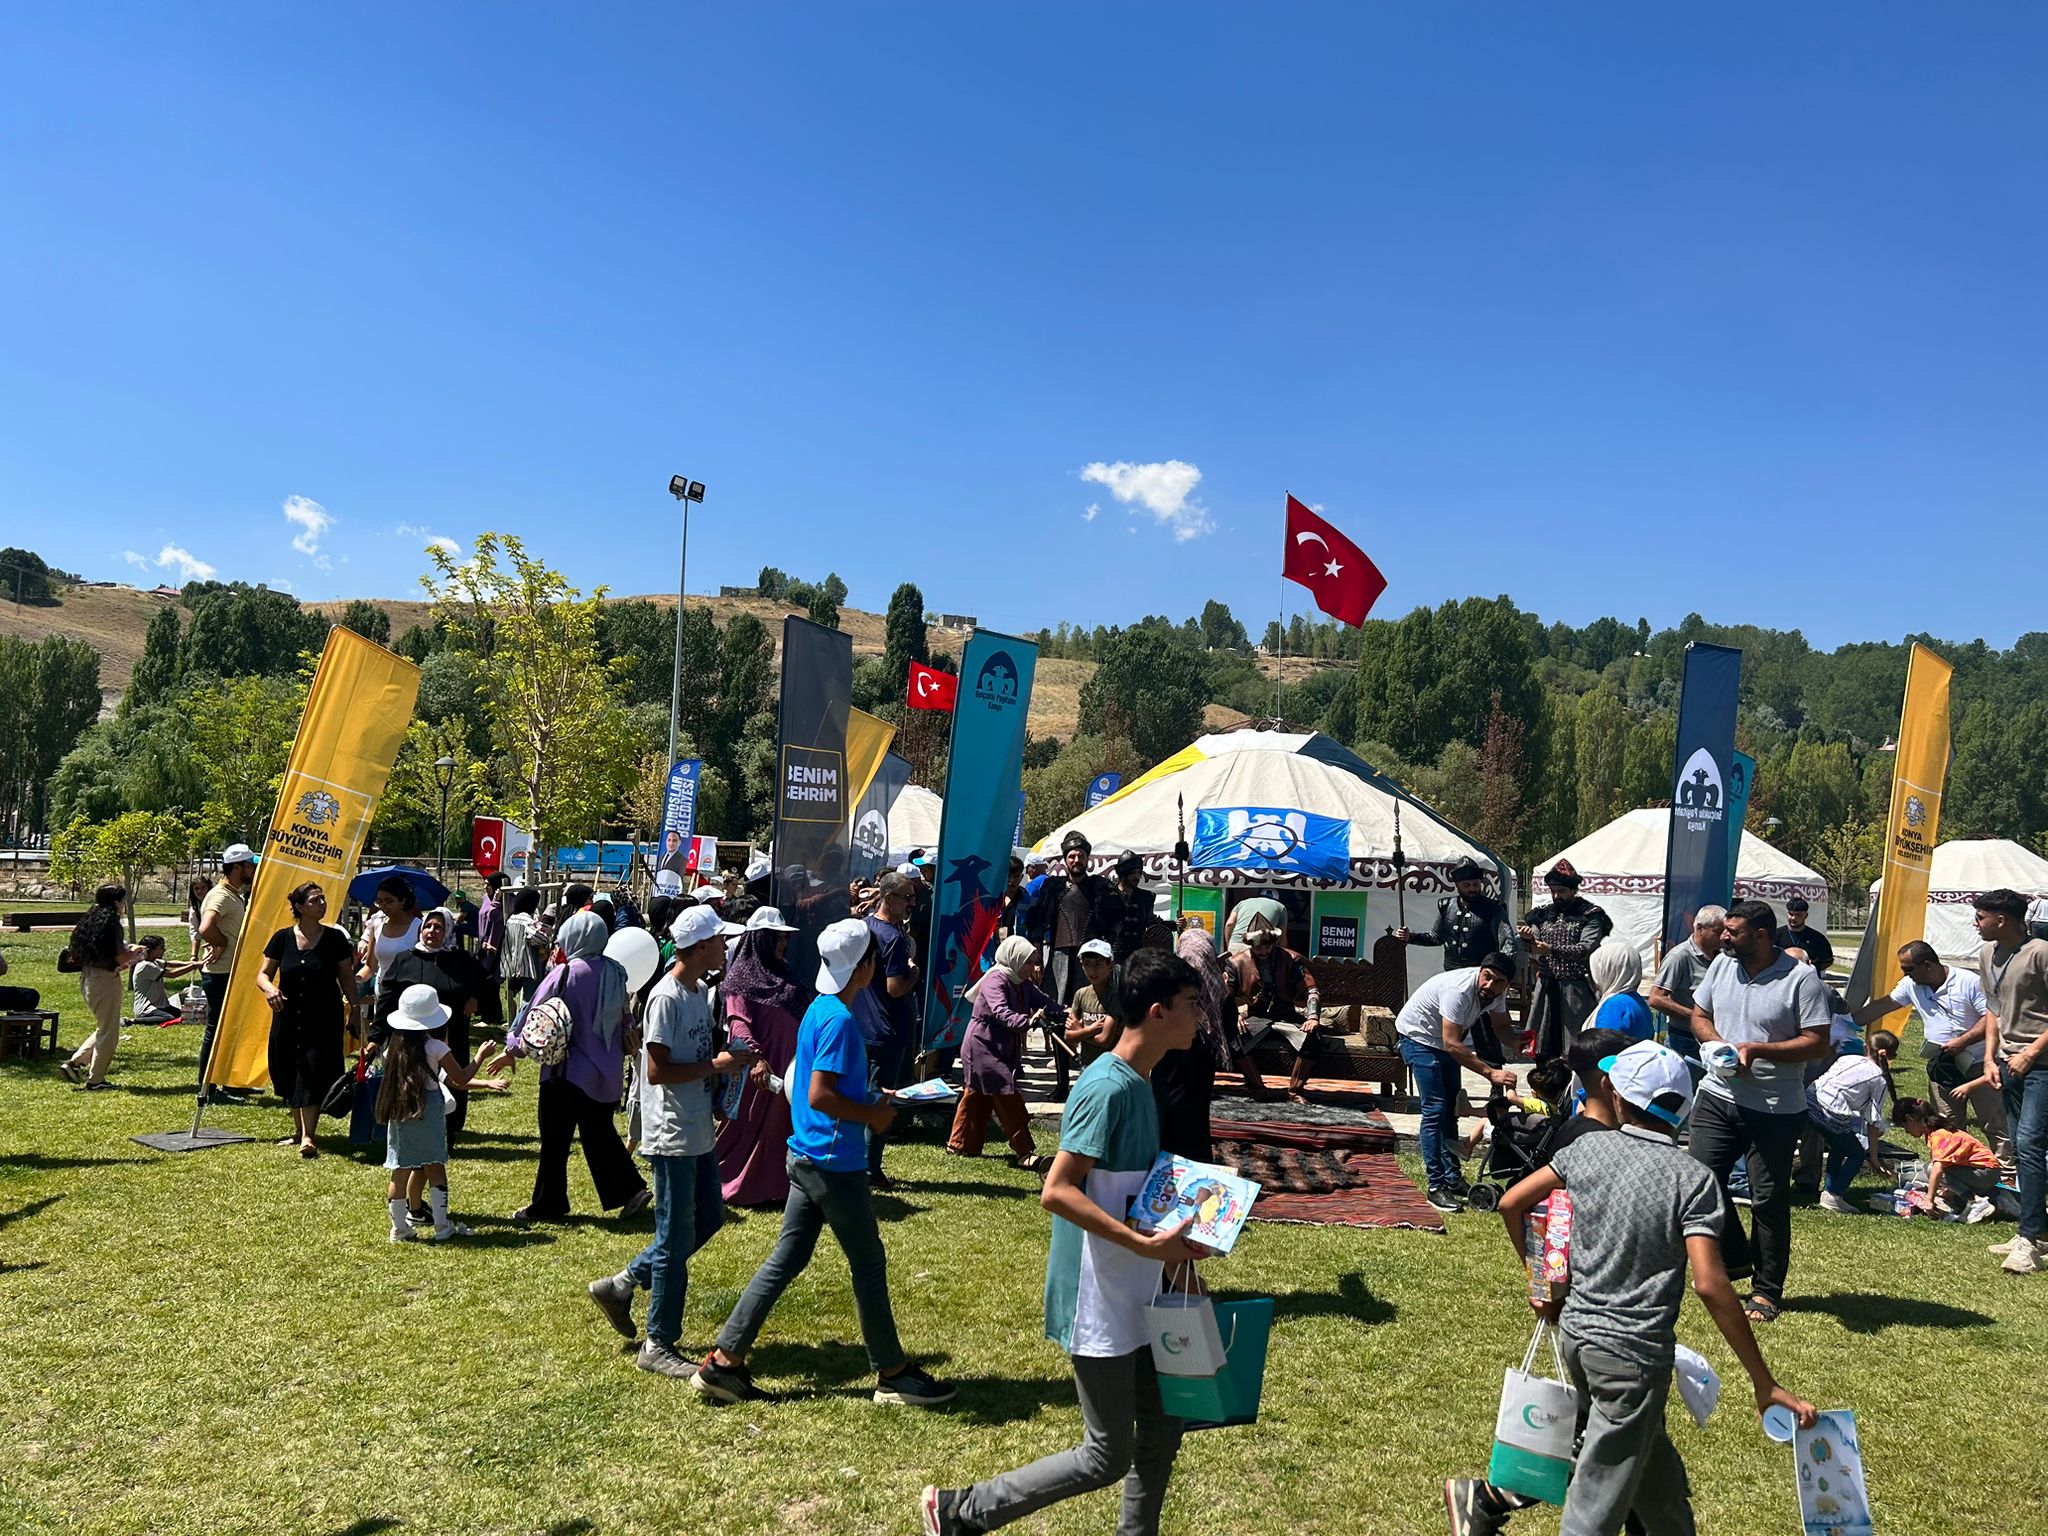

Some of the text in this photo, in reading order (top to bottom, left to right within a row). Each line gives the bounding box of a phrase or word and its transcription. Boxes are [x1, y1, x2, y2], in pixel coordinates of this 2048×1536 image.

[664, 776, 682, 832] TOROSLAR
[677, 778, 694, 838] BELEDİYESİ
[270, 829, 343, 859] BÜYÜKŞEHİR
[291, 823, 328, 842] KONYA
[279, 845, 325, 864] BELEDİYESİ
